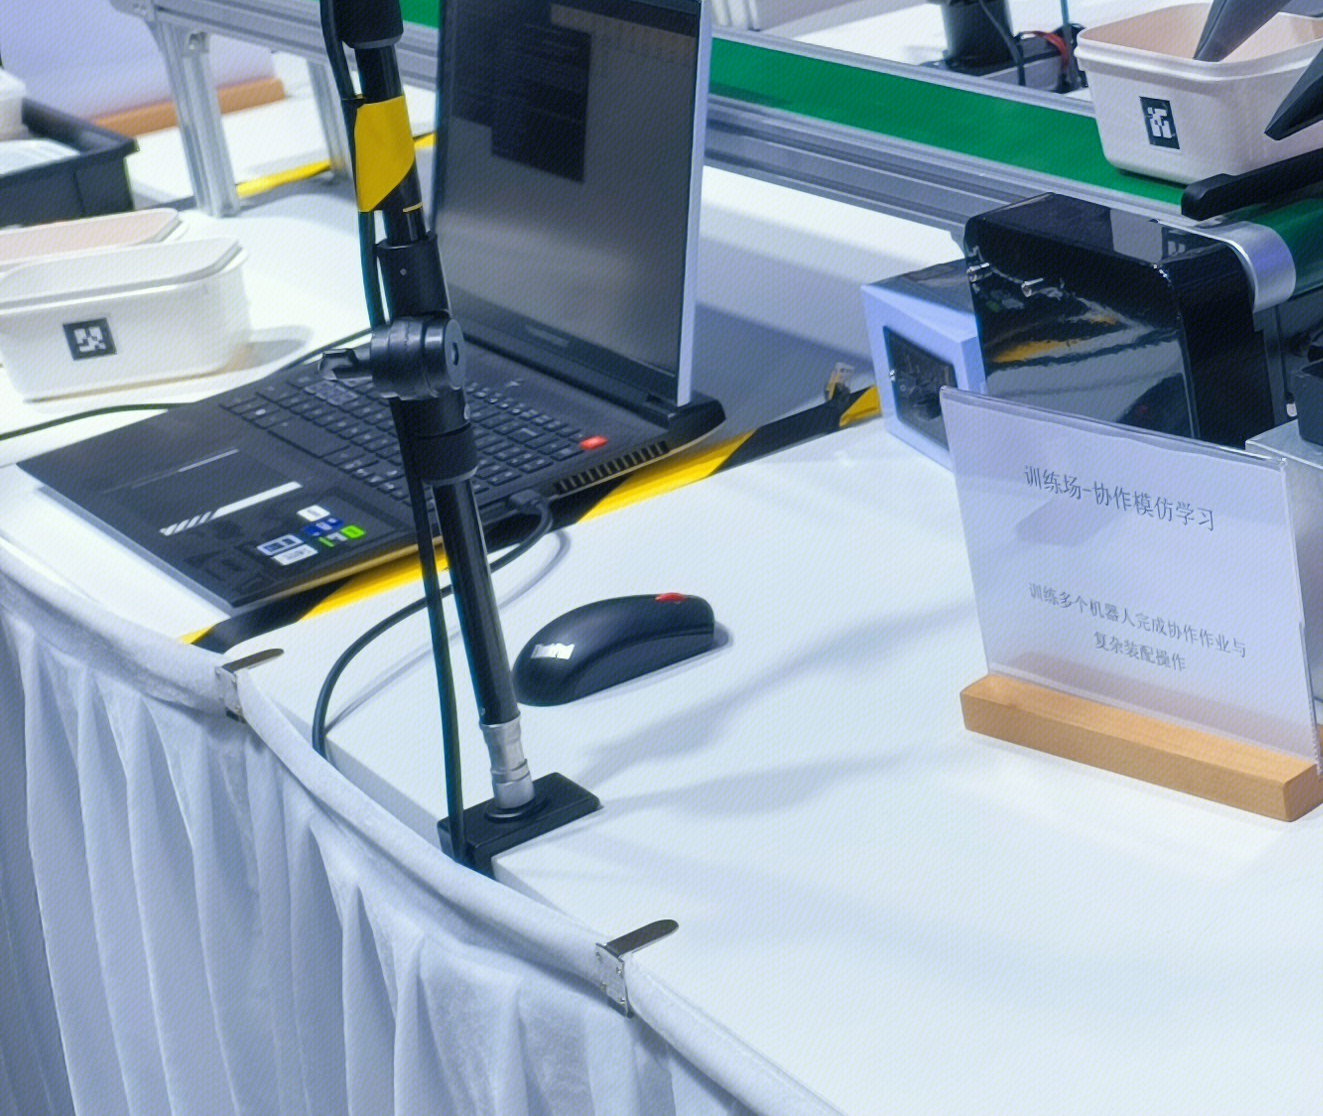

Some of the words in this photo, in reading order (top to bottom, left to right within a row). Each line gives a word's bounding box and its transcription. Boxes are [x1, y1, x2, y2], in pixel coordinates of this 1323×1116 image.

[1024, 465, 1215, 531] 训练场-协作模仿学习
[1029, 582, 1246, 658] 训练多个机器人完成协作作业与
[1093, 631, 1187, 672] 复杂装配操作
